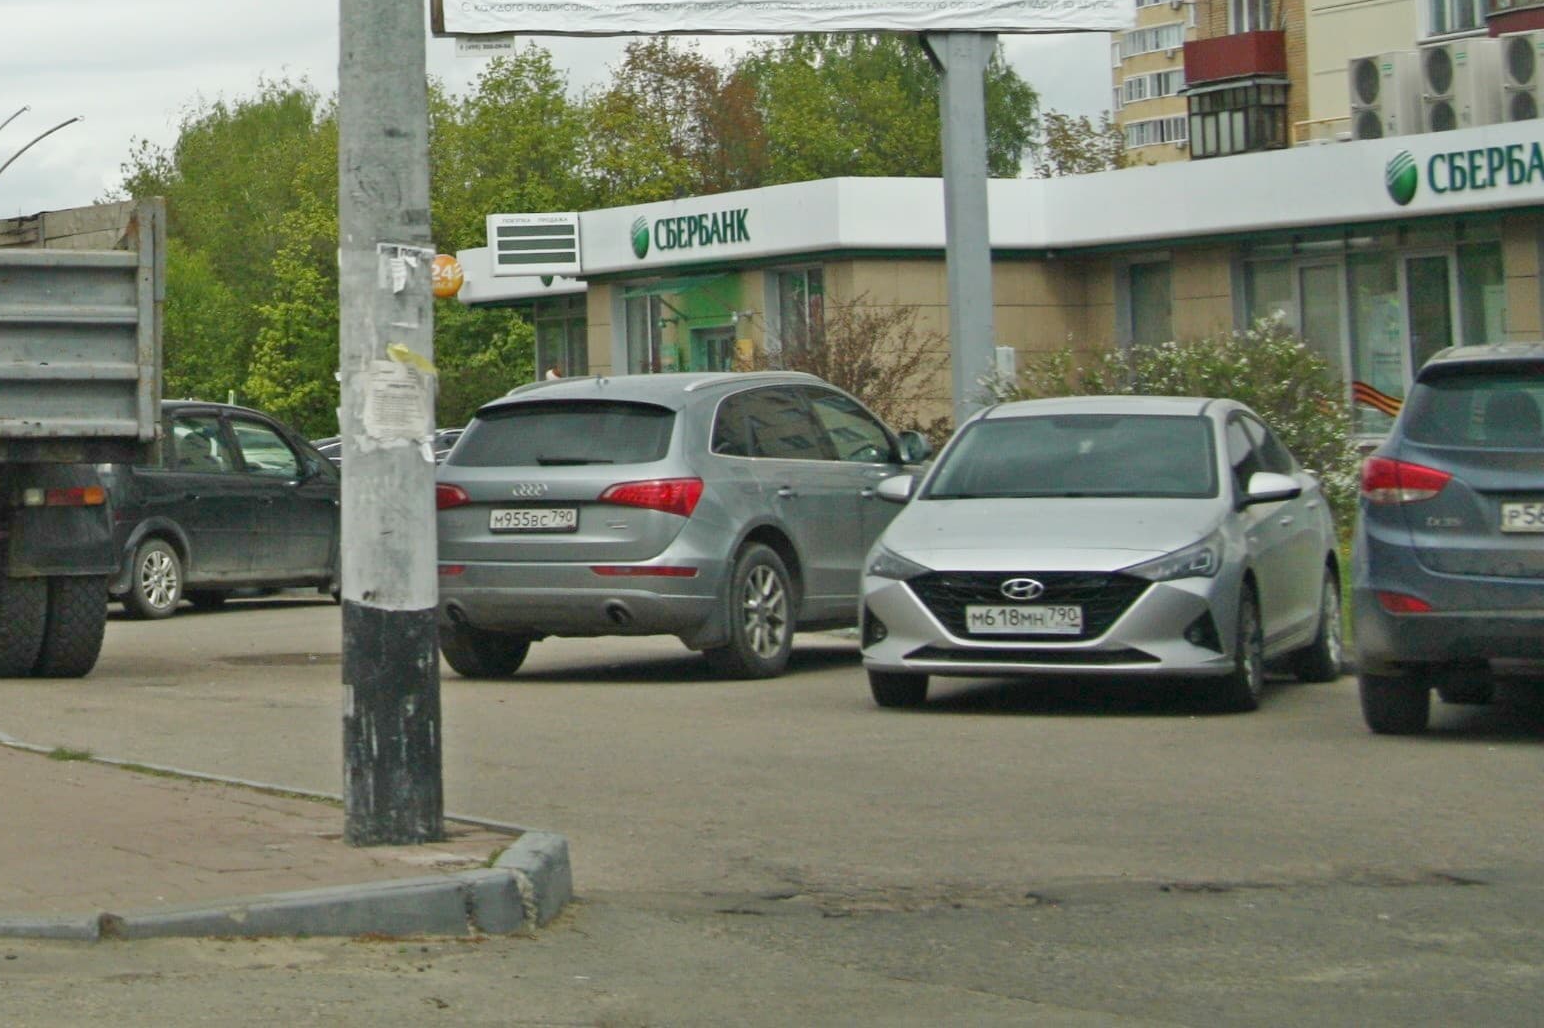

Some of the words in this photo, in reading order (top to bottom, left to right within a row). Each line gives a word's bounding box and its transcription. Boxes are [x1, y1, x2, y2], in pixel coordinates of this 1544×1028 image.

[655, 208, 750, 251] СБЕРБАНК
[495, 512, 548, 527] М955ВС
[552, 510, 574, 522] 790
[971, 609, 1045, 627] М618МН
[1048, 607, 1077, 621] 790
